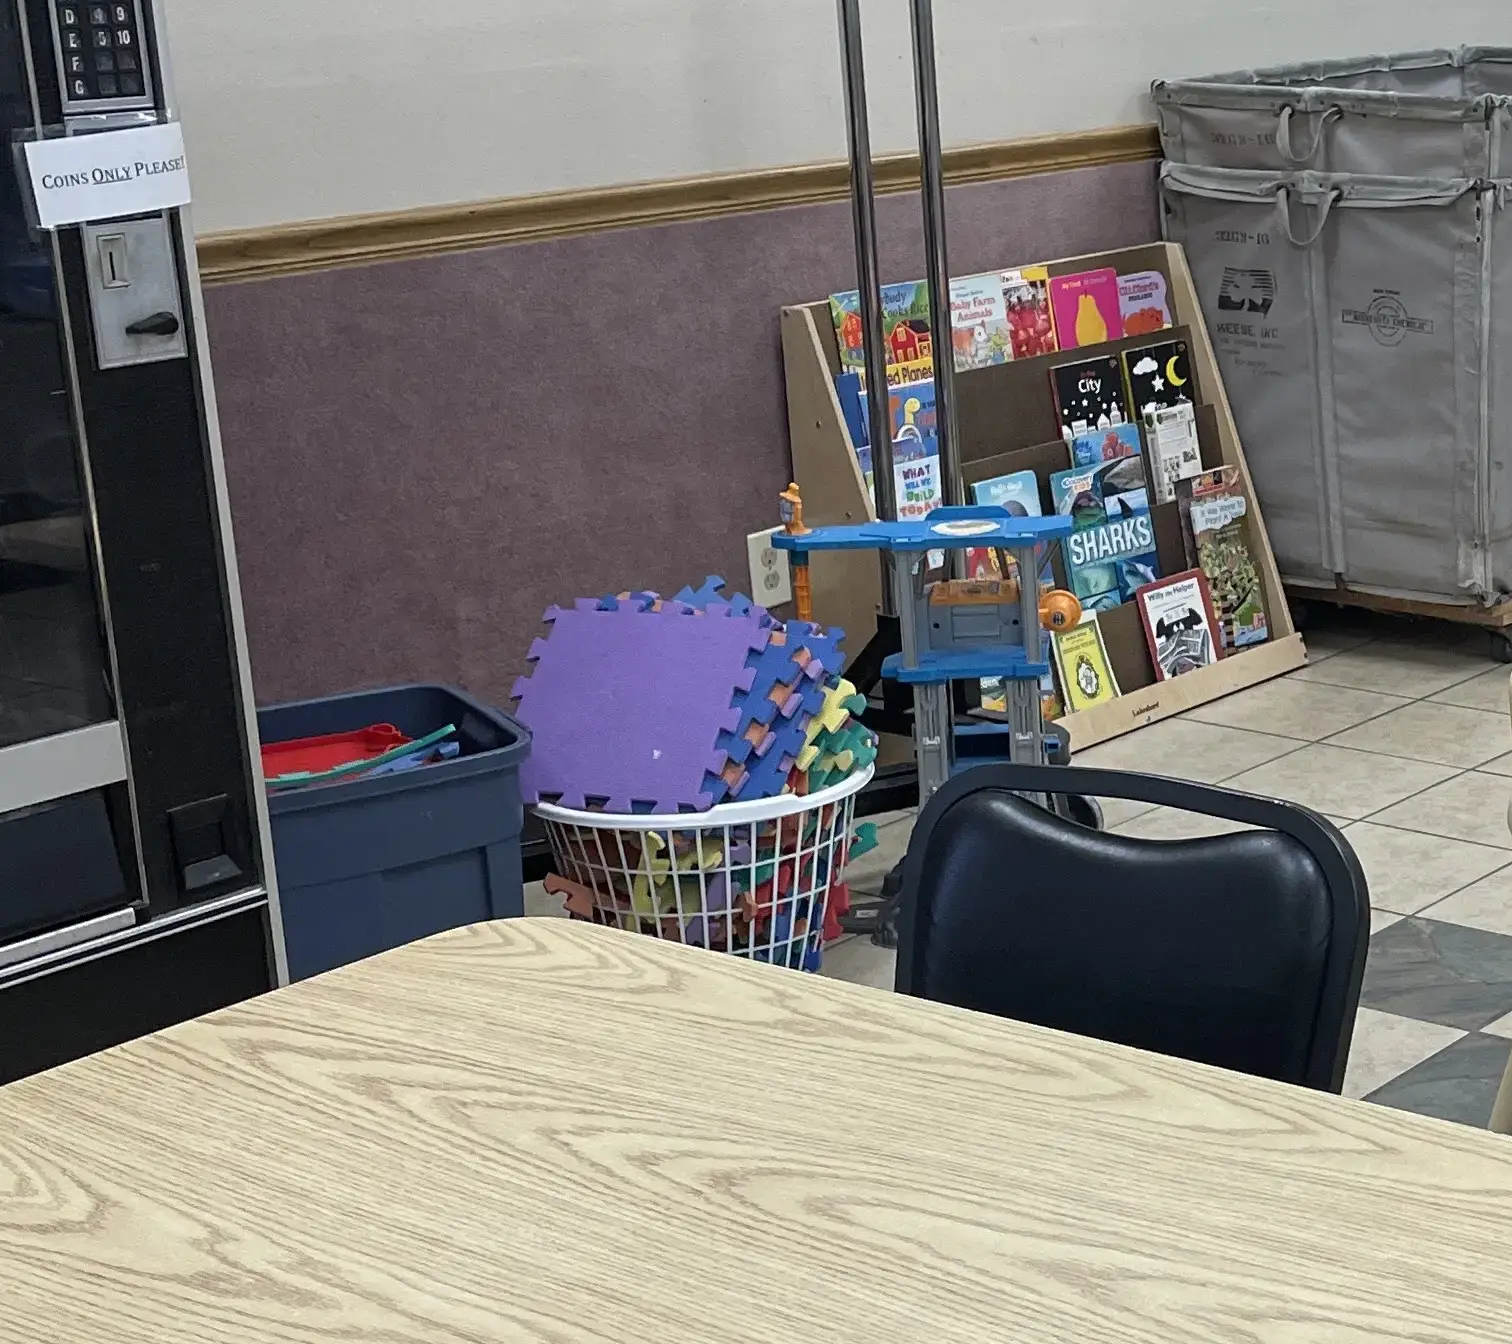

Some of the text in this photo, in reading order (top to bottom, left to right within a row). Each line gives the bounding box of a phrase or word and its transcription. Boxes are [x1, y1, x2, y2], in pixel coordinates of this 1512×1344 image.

[65, 9, 74, 24] D
[116, 6, 124, 21] 9
[69, 30, 130, 48] E 5 10
[72, 56, 80, 71] F
[75, 80, 84, 95] G
[42, 172, 89, 189] COINS
[91, 167, 133, 185] ONLY
[949, 296, 996, 312] Baby Farm
[957, 308, 993, 322] Animals
[901, 364, 933, 383] Planes
[1078, 378, 1102, 394] City
[902, 464, 931, 481] WHAT
[905, 477, 931, 490] WILL WE
[1069, 517, 1151, 565] SHARKS
[1147, 591, 1165, 602] Willy
[1173, 583, 1194, 594] Helper
